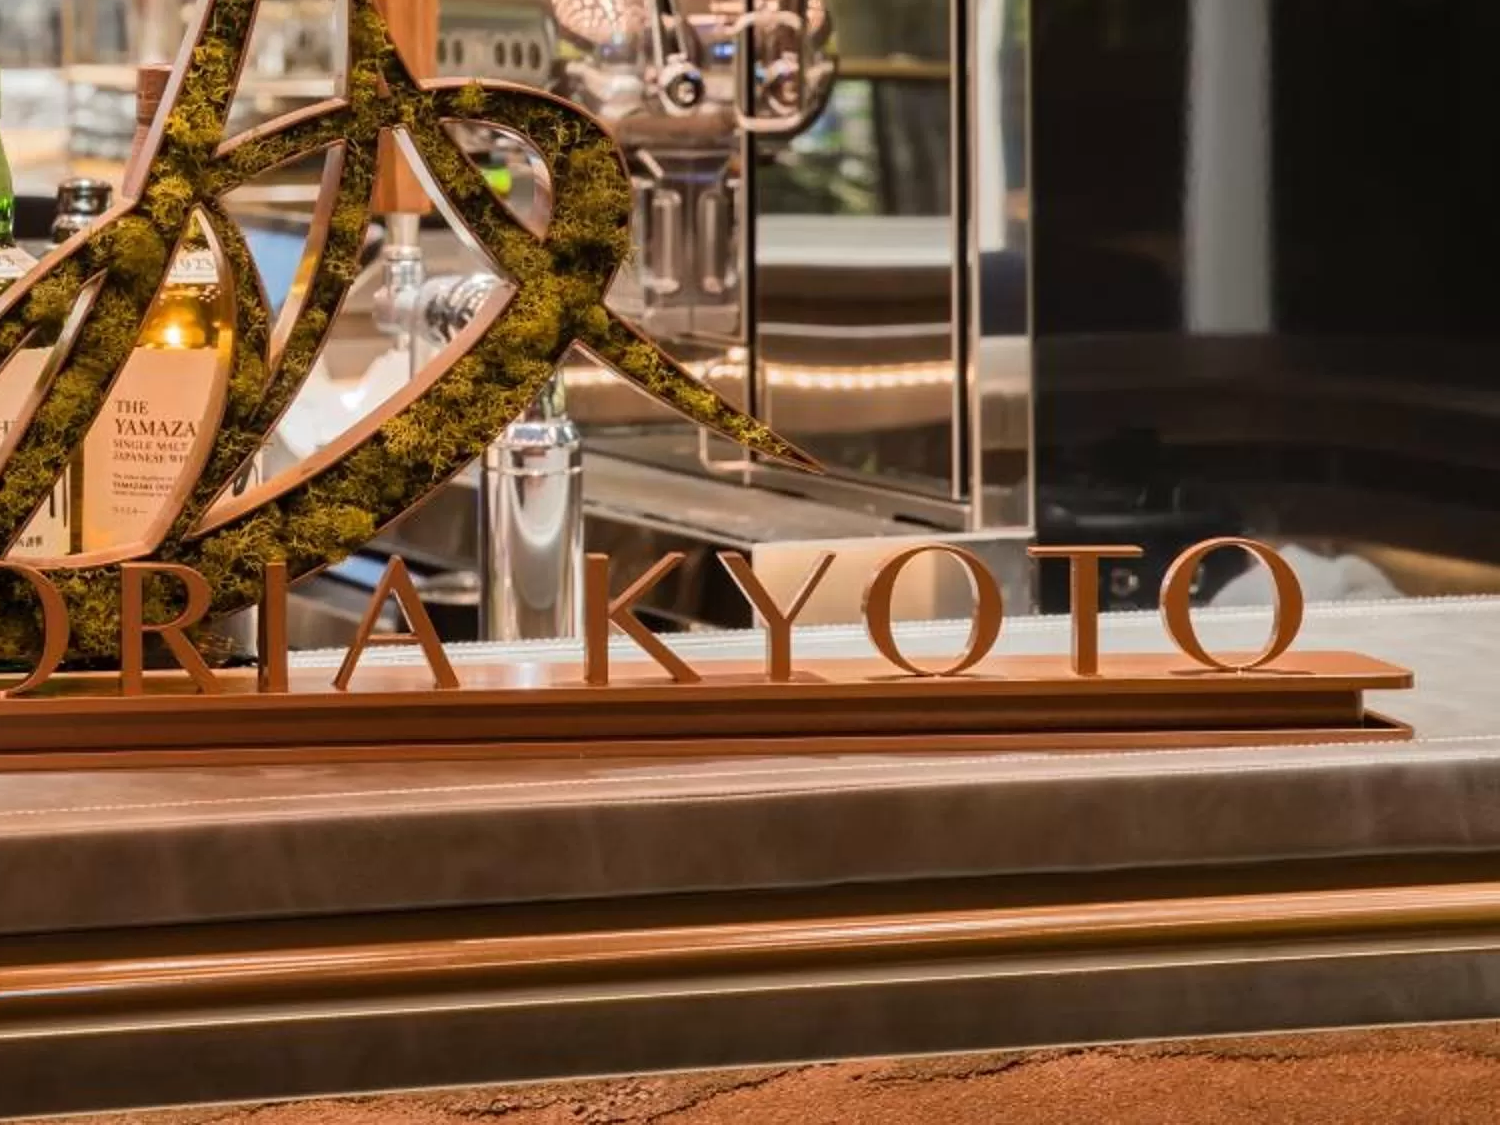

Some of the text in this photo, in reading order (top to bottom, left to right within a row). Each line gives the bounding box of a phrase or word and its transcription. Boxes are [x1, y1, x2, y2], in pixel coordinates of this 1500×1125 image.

[115, 400, 149, 415] THE
[115, 418, 197, 437] YAMAZA
[113, 439, 190, 452] SINGLE MALT
[113, 452, 163, 463] JAPANESE
[584, 536, 1304, 685] KYOTO
